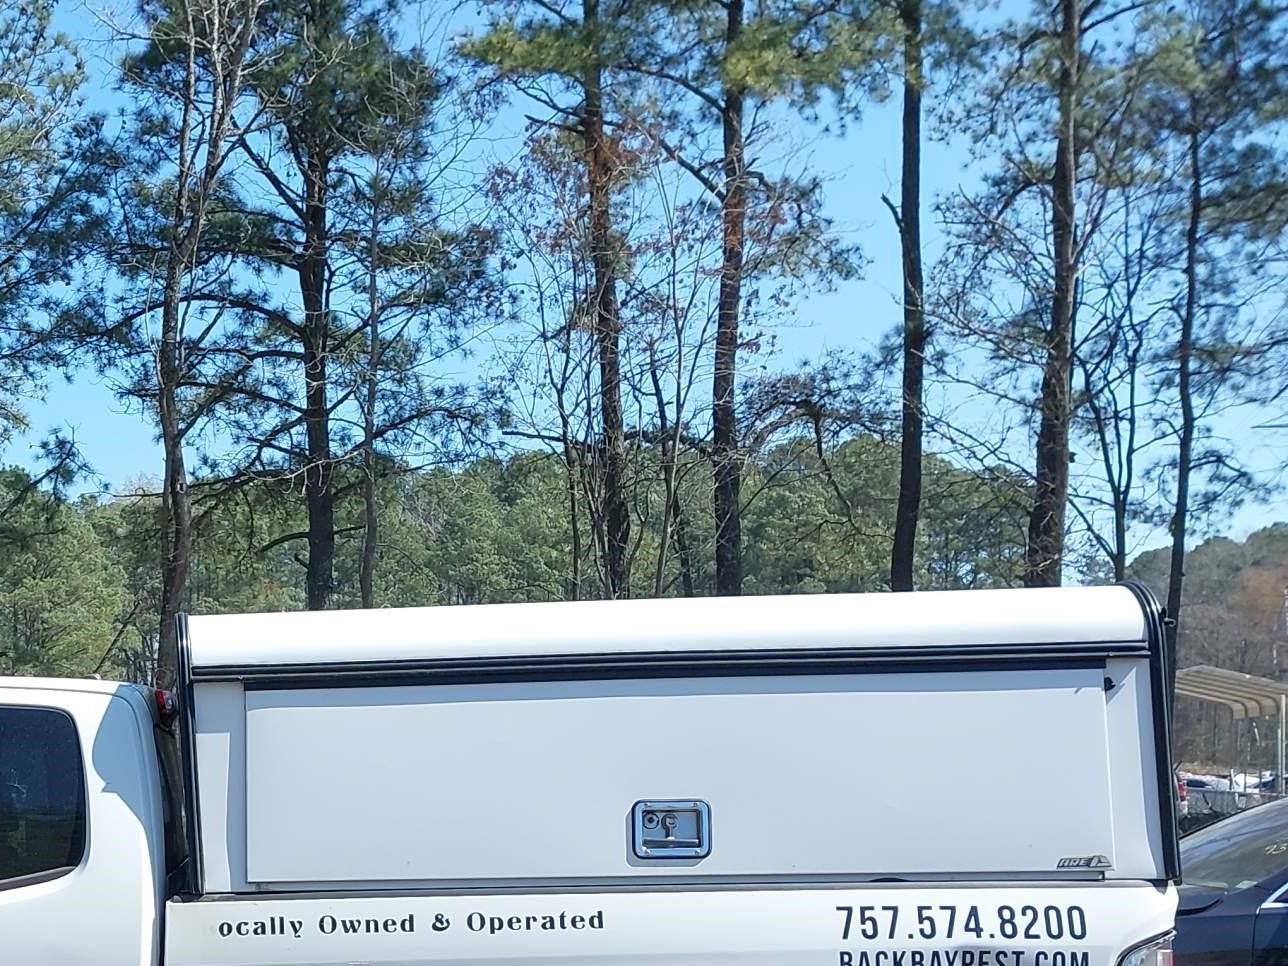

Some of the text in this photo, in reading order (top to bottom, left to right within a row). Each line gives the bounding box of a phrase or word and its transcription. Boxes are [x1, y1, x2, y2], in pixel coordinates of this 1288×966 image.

[318, 914, 416, 935] Owned
[431, 912, 451, 933] &
[466, 910, 605, 935] Operated
[835, 905, 1088, 940] 757.574.8200
